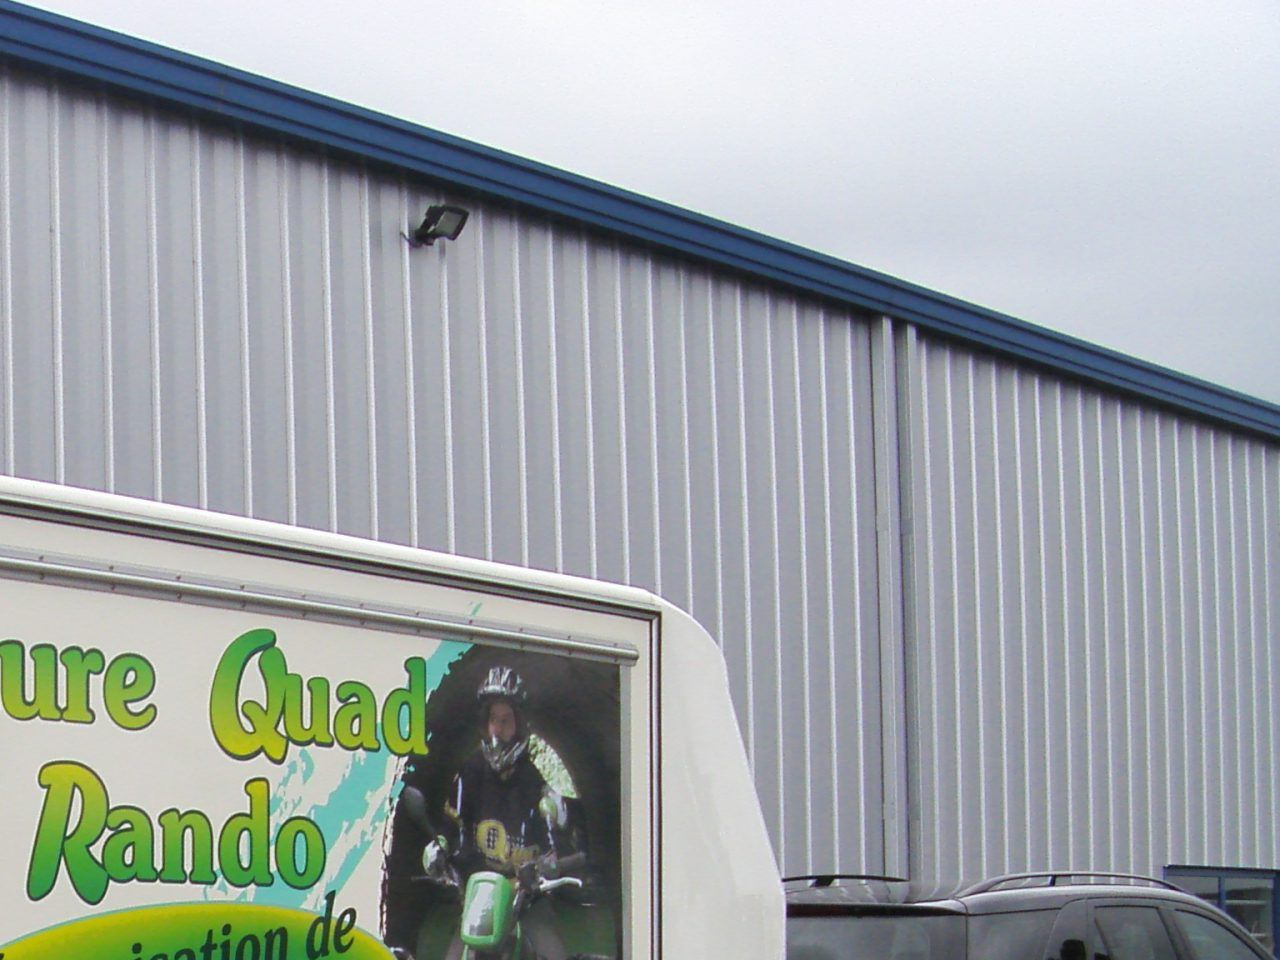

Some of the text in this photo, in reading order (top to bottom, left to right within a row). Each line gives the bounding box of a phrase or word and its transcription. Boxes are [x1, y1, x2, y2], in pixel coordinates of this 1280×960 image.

[208, 628, 429, 762] Quad
[26, 760, 327, 905] Rando
[305, 890, 357, 959] de
